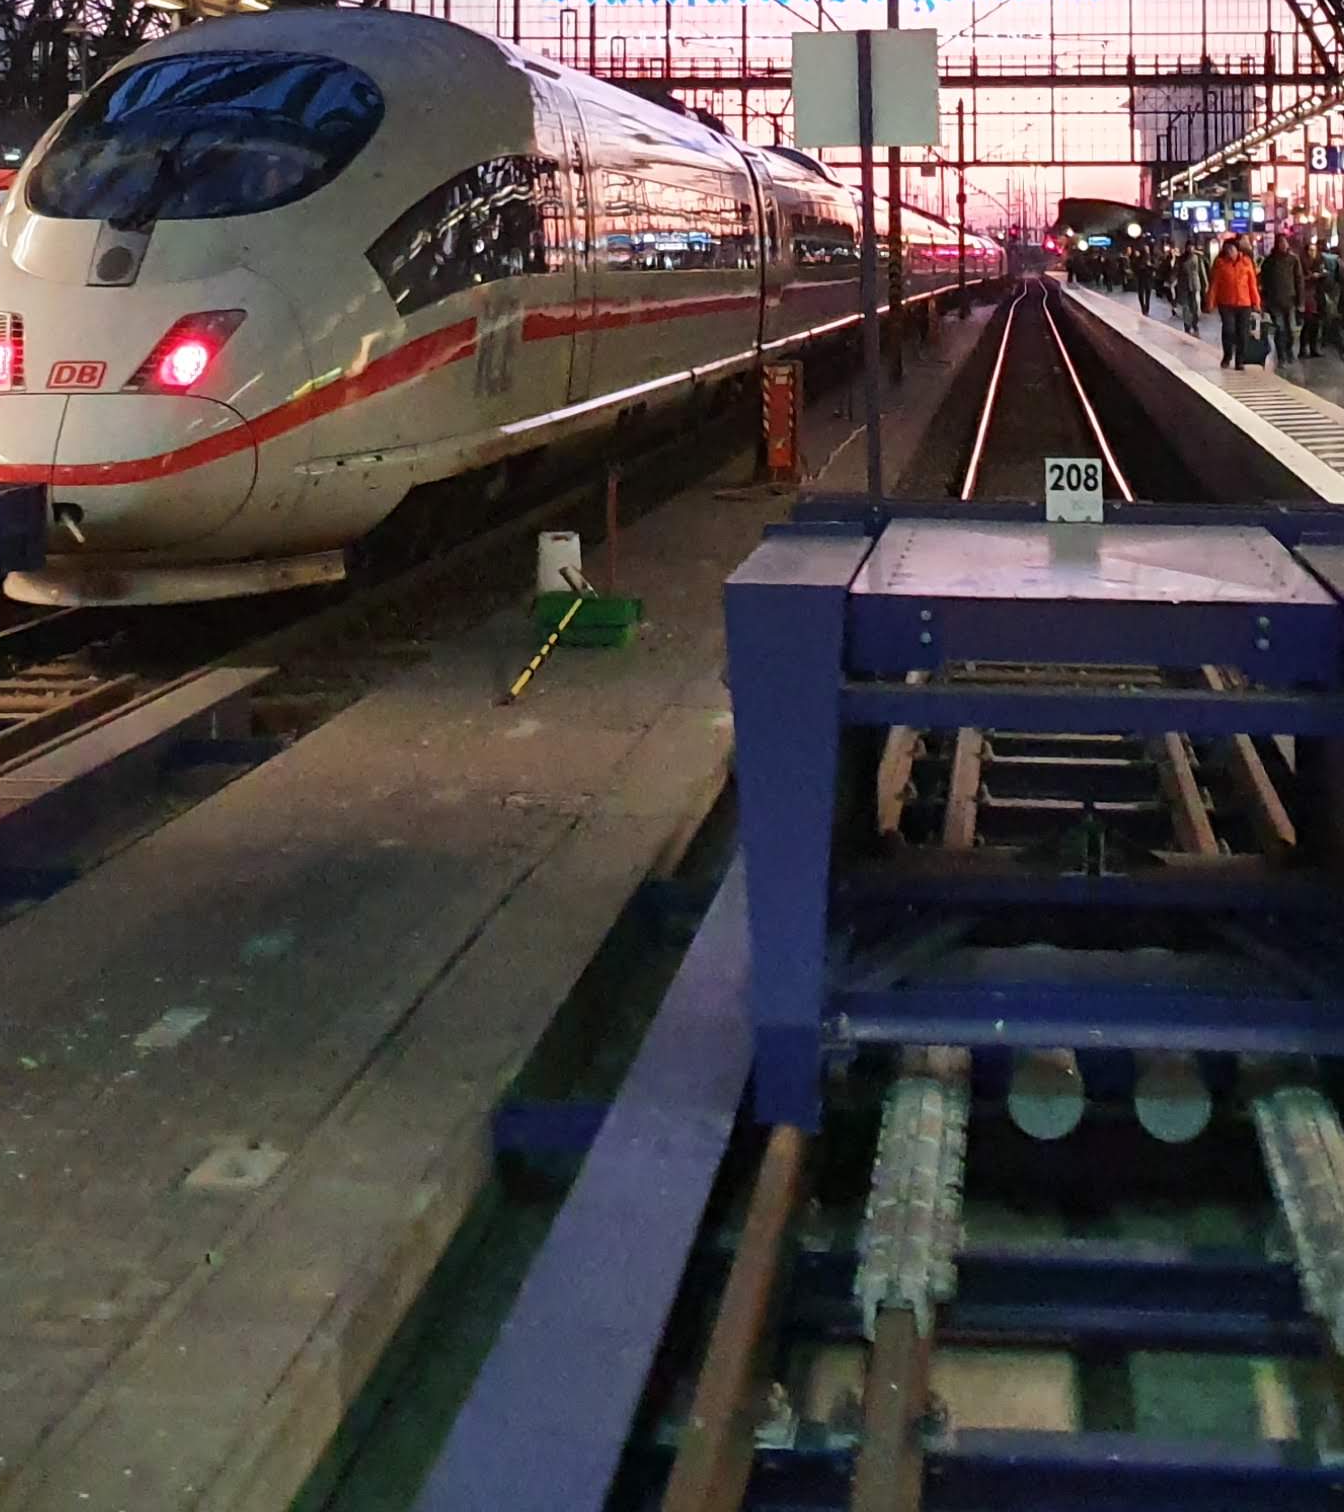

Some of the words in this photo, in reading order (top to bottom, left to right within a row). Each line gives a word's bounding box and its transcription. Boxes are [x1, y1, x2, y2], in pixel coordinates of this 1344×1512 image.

[1311, 146, 1328, 169] 8
[54, 365, 96, 384] DB
[1049, 463, 1099, 491] 208
